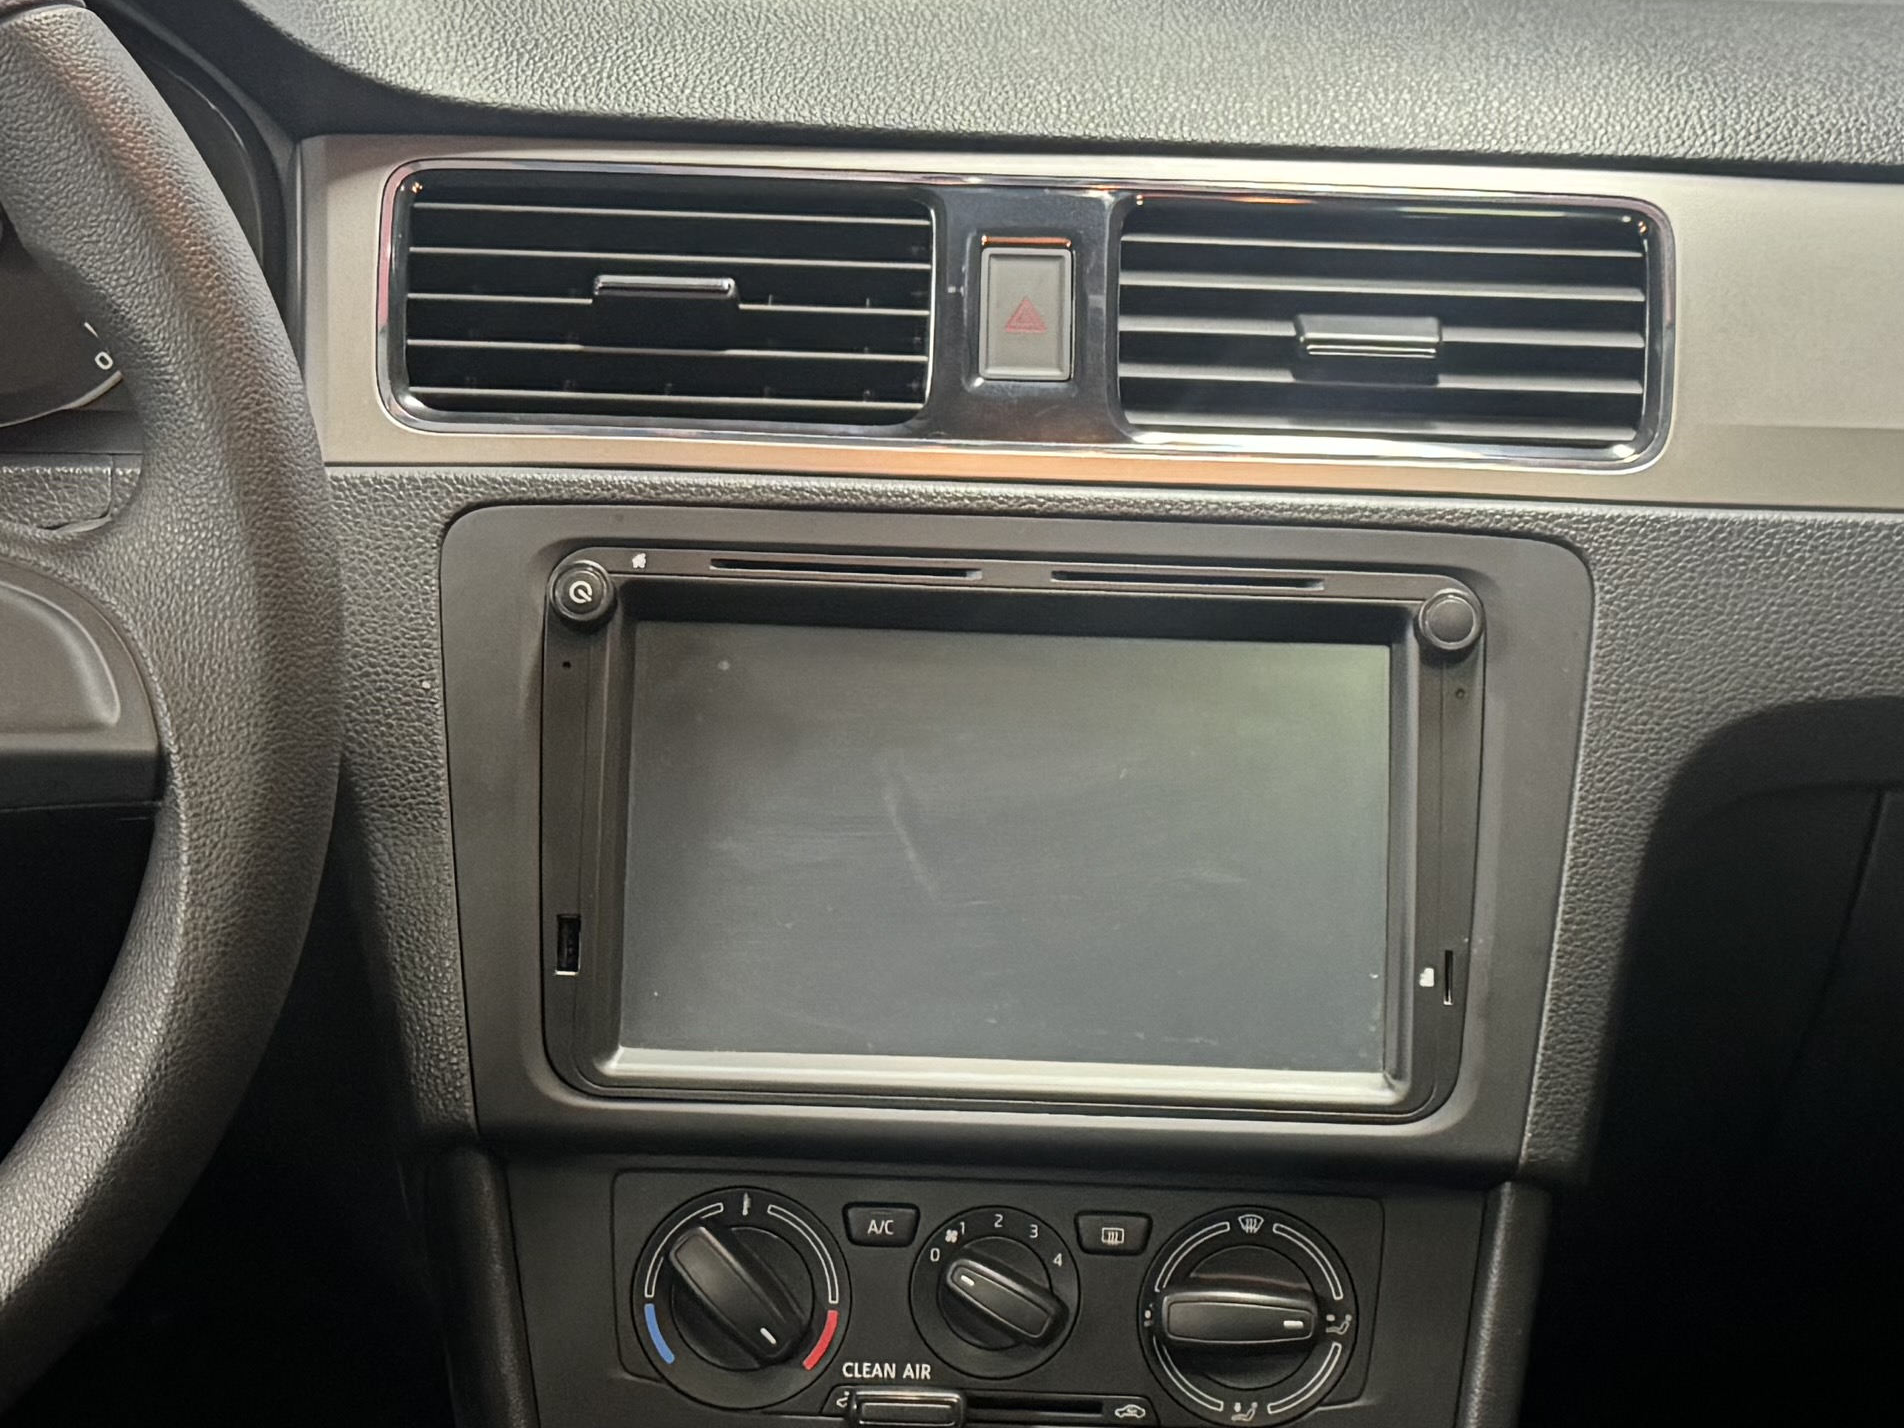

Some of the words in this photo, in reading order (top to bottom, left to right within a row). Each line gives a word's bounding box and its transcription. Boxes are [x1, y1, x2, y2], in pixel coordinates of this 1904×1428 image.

[867, 1220, 894, 1236] A/C
[994, 1214, 1003, 1228] 2
[1029, 1224, 1039, 1239] 3
[930, 1248, 940, 1262] 0
[1053, 1253, 1063, 1267] 4
[842, 1362, 896, 1380] CLEAN
[902, 1363, 932, 1380] AIR
